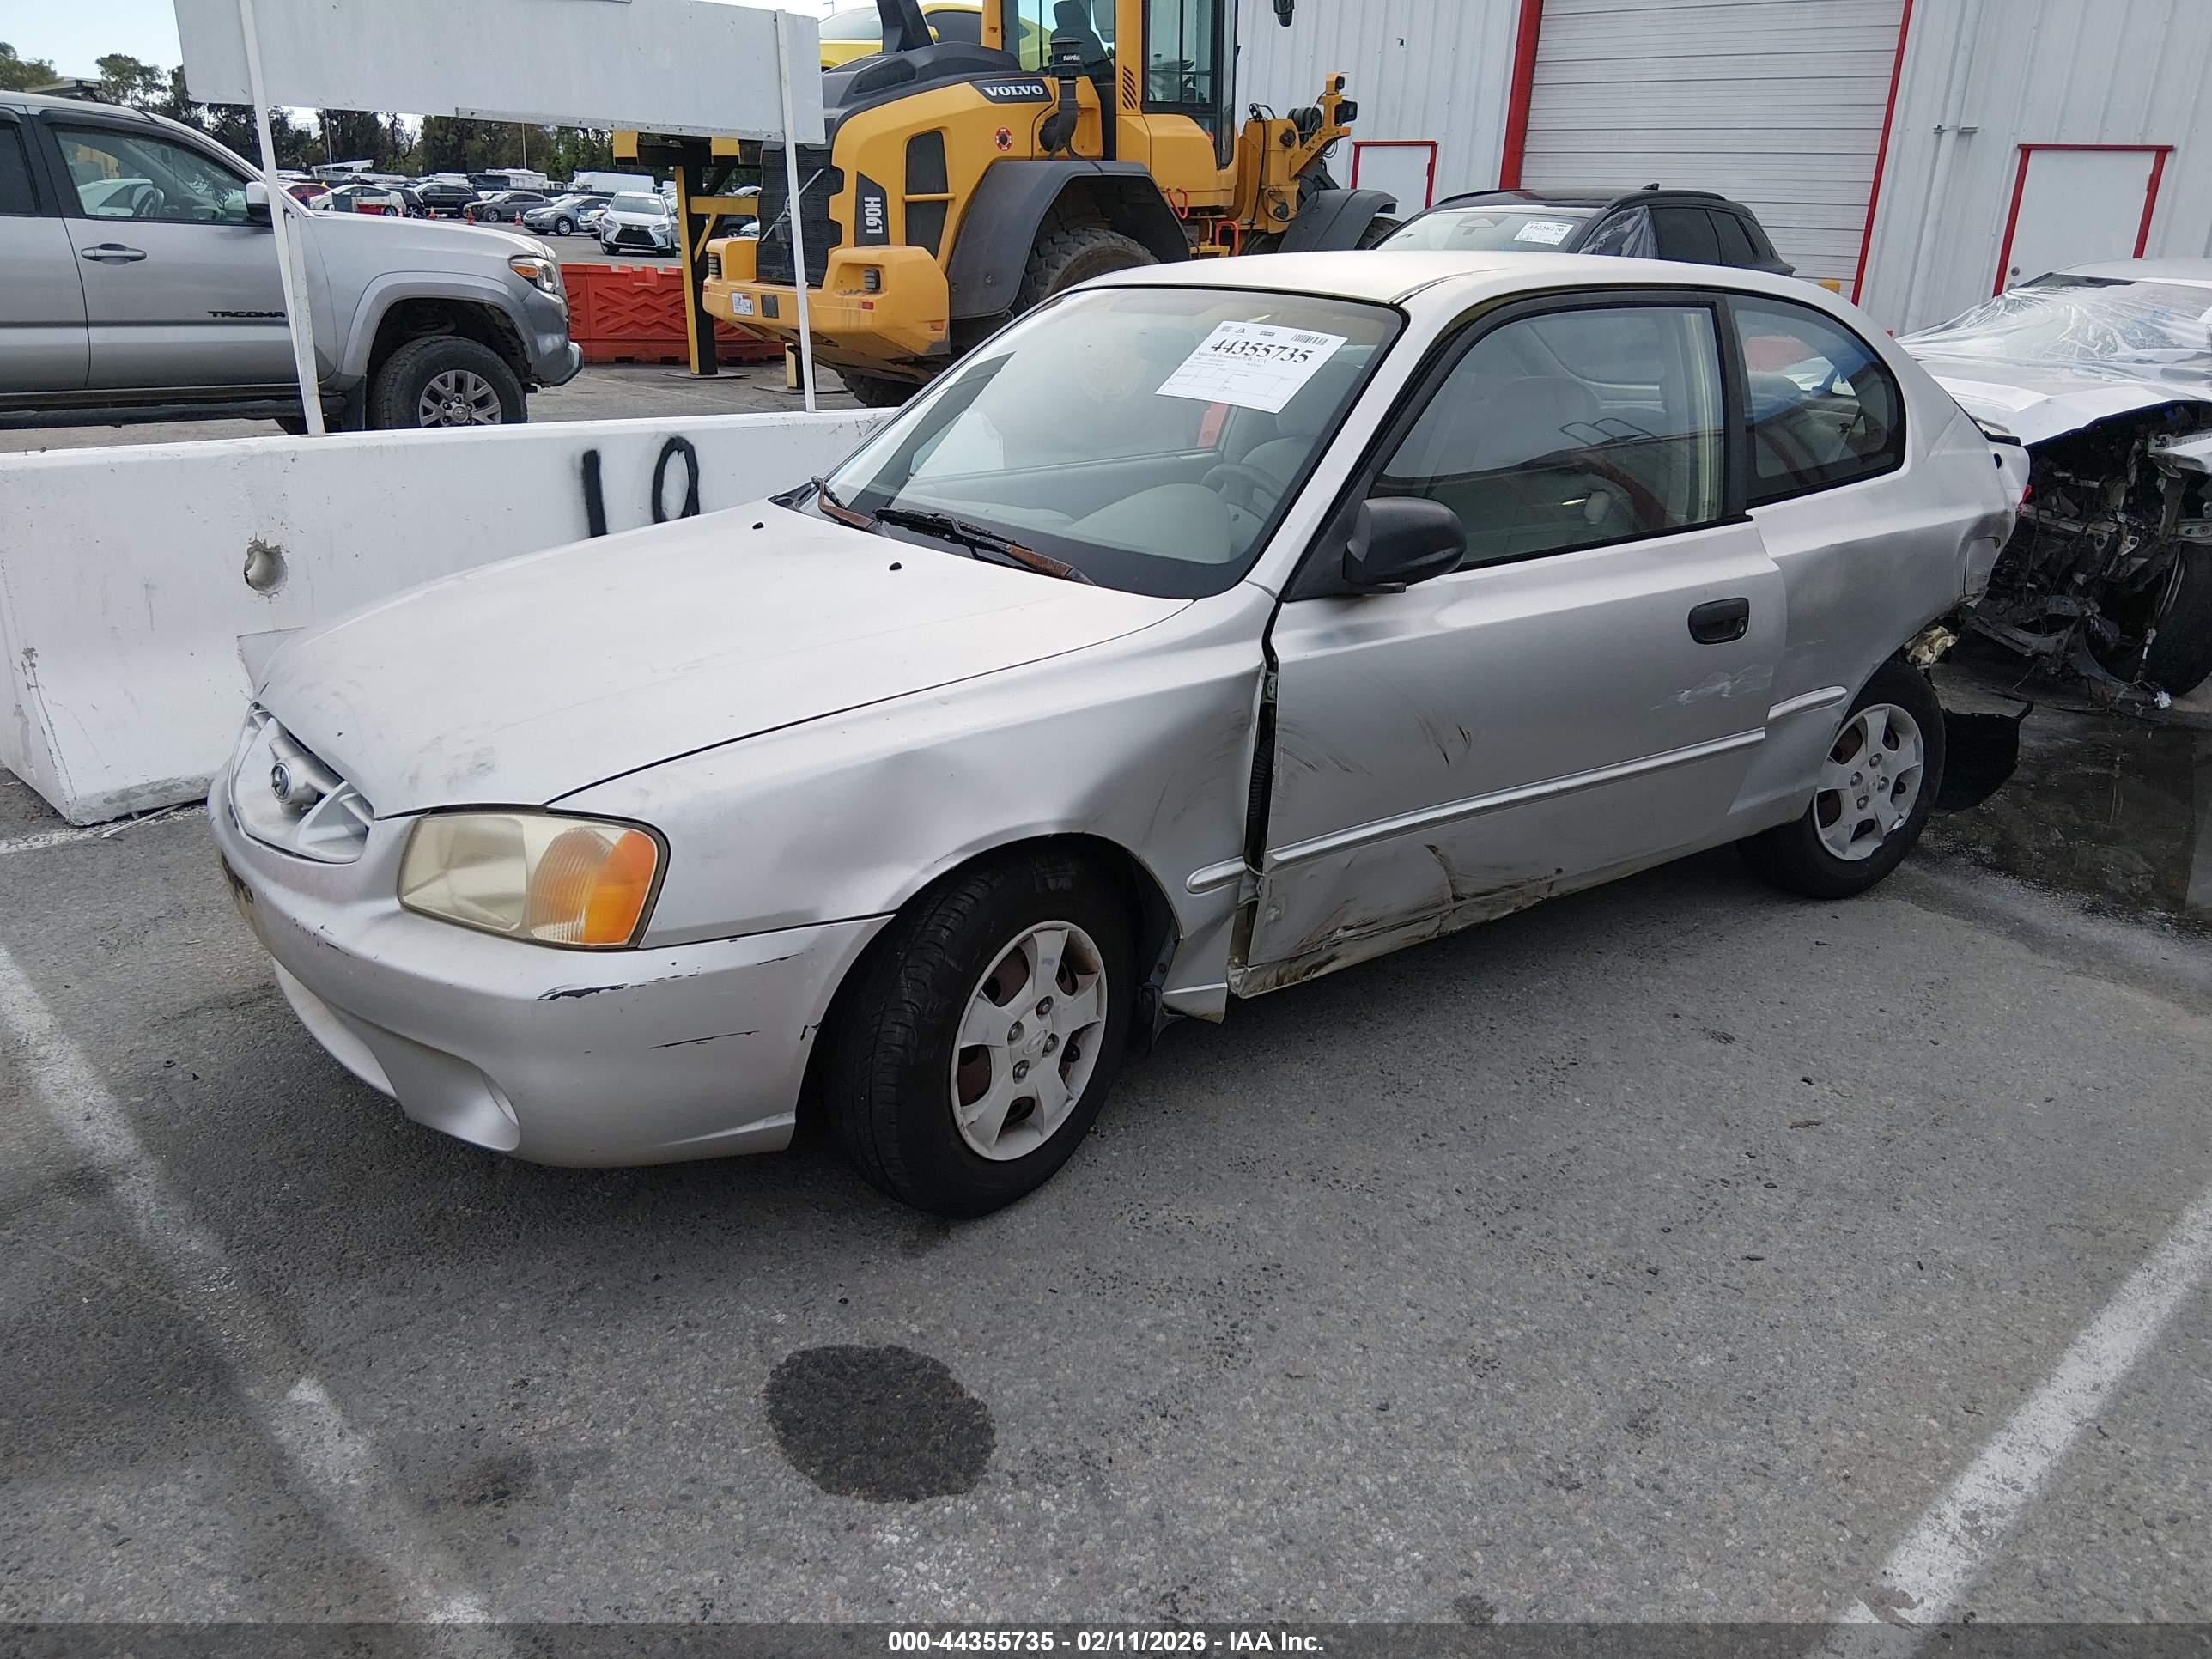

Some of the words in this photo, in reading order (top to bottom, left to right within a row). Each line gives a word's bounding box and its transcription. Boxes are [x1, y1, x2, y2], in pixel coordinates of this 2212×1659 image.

[982, 85, 1044, 96] VOLVO
[864, 197, 883, 234] L90H
[1211, 338, 1315, 364] 44355735
